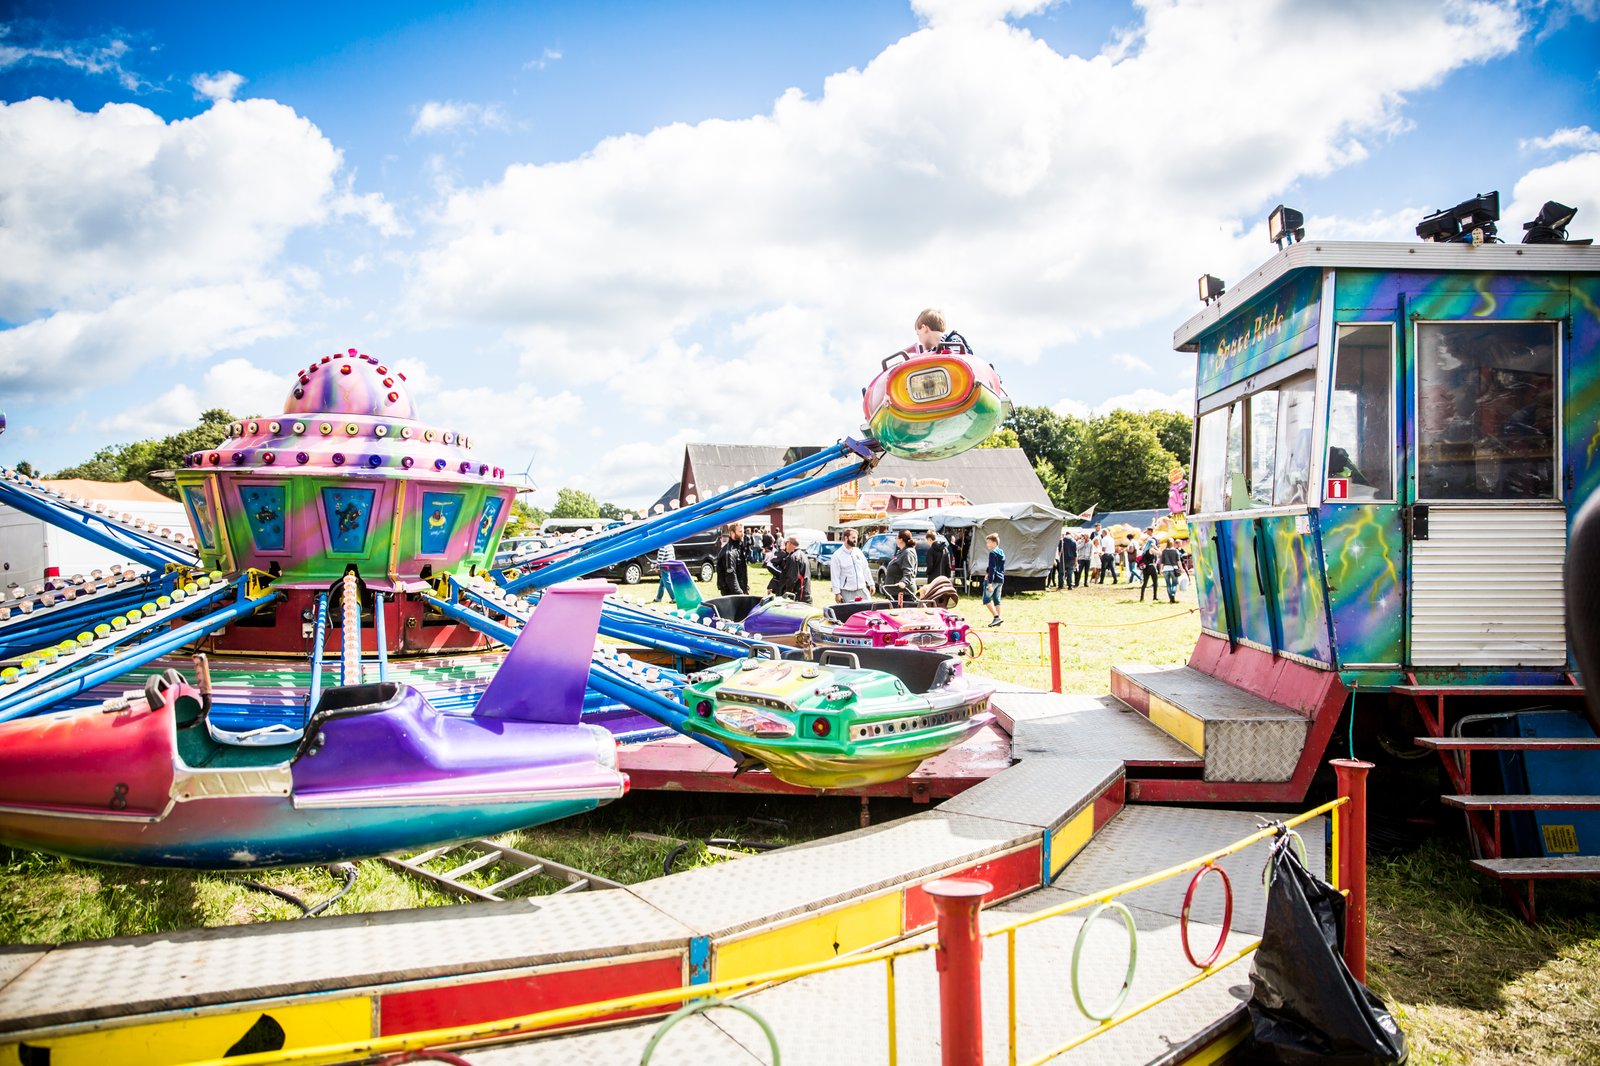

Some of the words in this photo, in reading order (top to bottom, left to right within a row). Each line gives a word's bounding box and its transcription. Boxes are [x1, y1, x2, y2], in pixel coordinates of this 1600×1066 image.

[1215, 329, 1250, 372] Space
[1252, 303, 1284, 346] Ride
[893, 679, 905, 697] 9
[109, 782, 129, 811] 8
